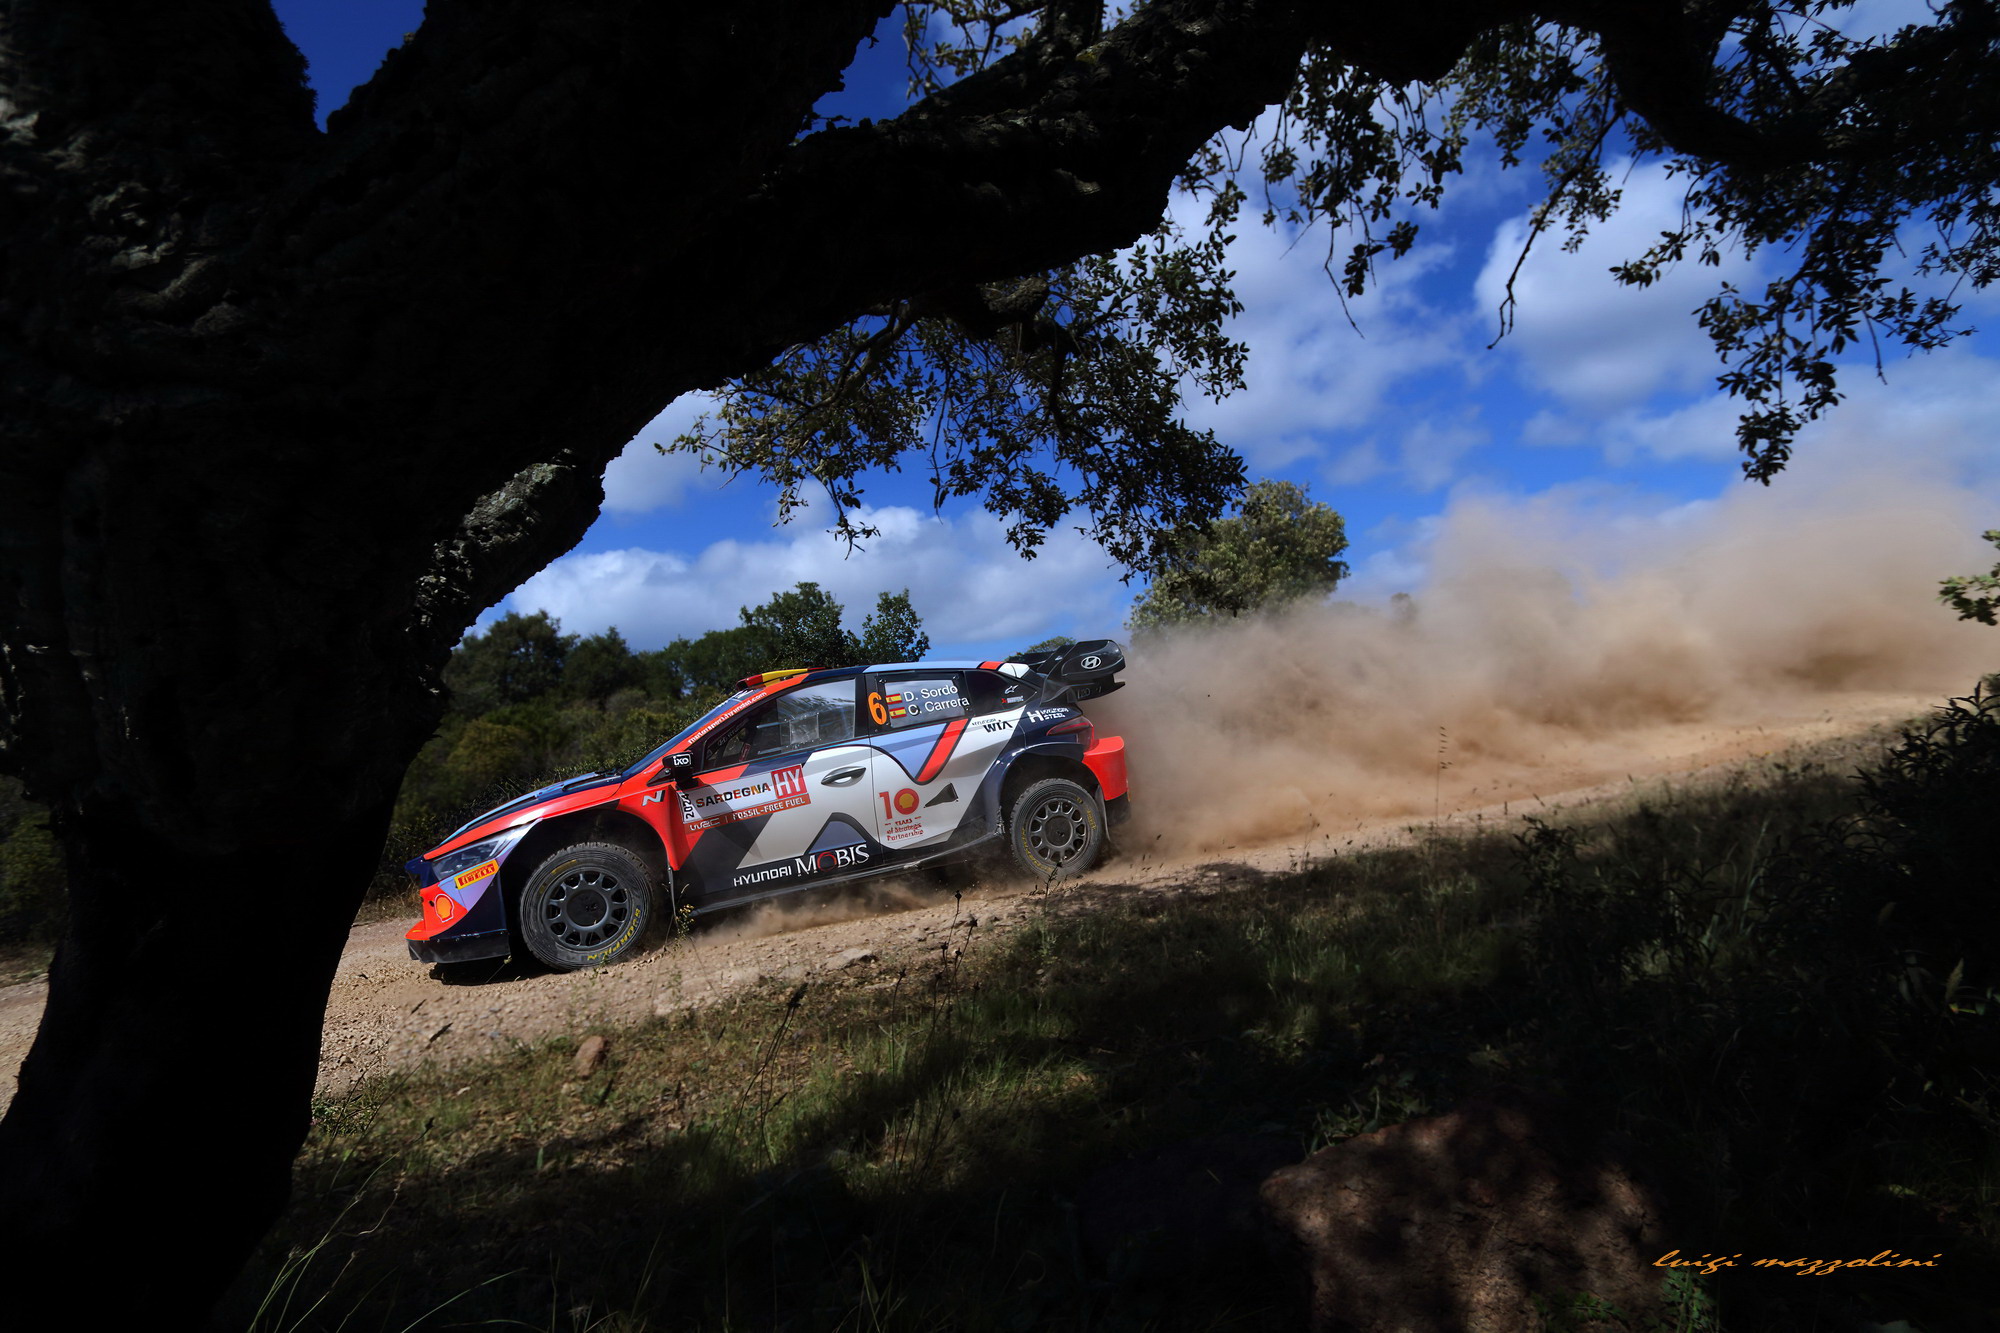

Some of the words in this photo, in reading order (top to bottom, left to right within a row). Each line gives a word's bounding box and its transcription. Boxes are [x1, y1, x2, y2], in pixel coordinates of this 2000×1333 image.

[904, 691, 919, 702] D.
[921, 685, 958, 699] Sordo
[868, 692, 887, 725] 6
[908, 704, 922, 715] C.
[924, 697, 970, 712] Carrera
[983, 720, 1013, 733] WIA
[696, 783, 771, 808] SARDEGNA
[774, 769, 801, 797] HY
[733, 804, 783, 820] FOSSIL-FREE
[785, 798, 806, 809] FUEL
[887, 829, 924, 841] Partnership
[733, 865, 792, 887] HYUNDAI
[795, 844, 869, 877] MOBIS
